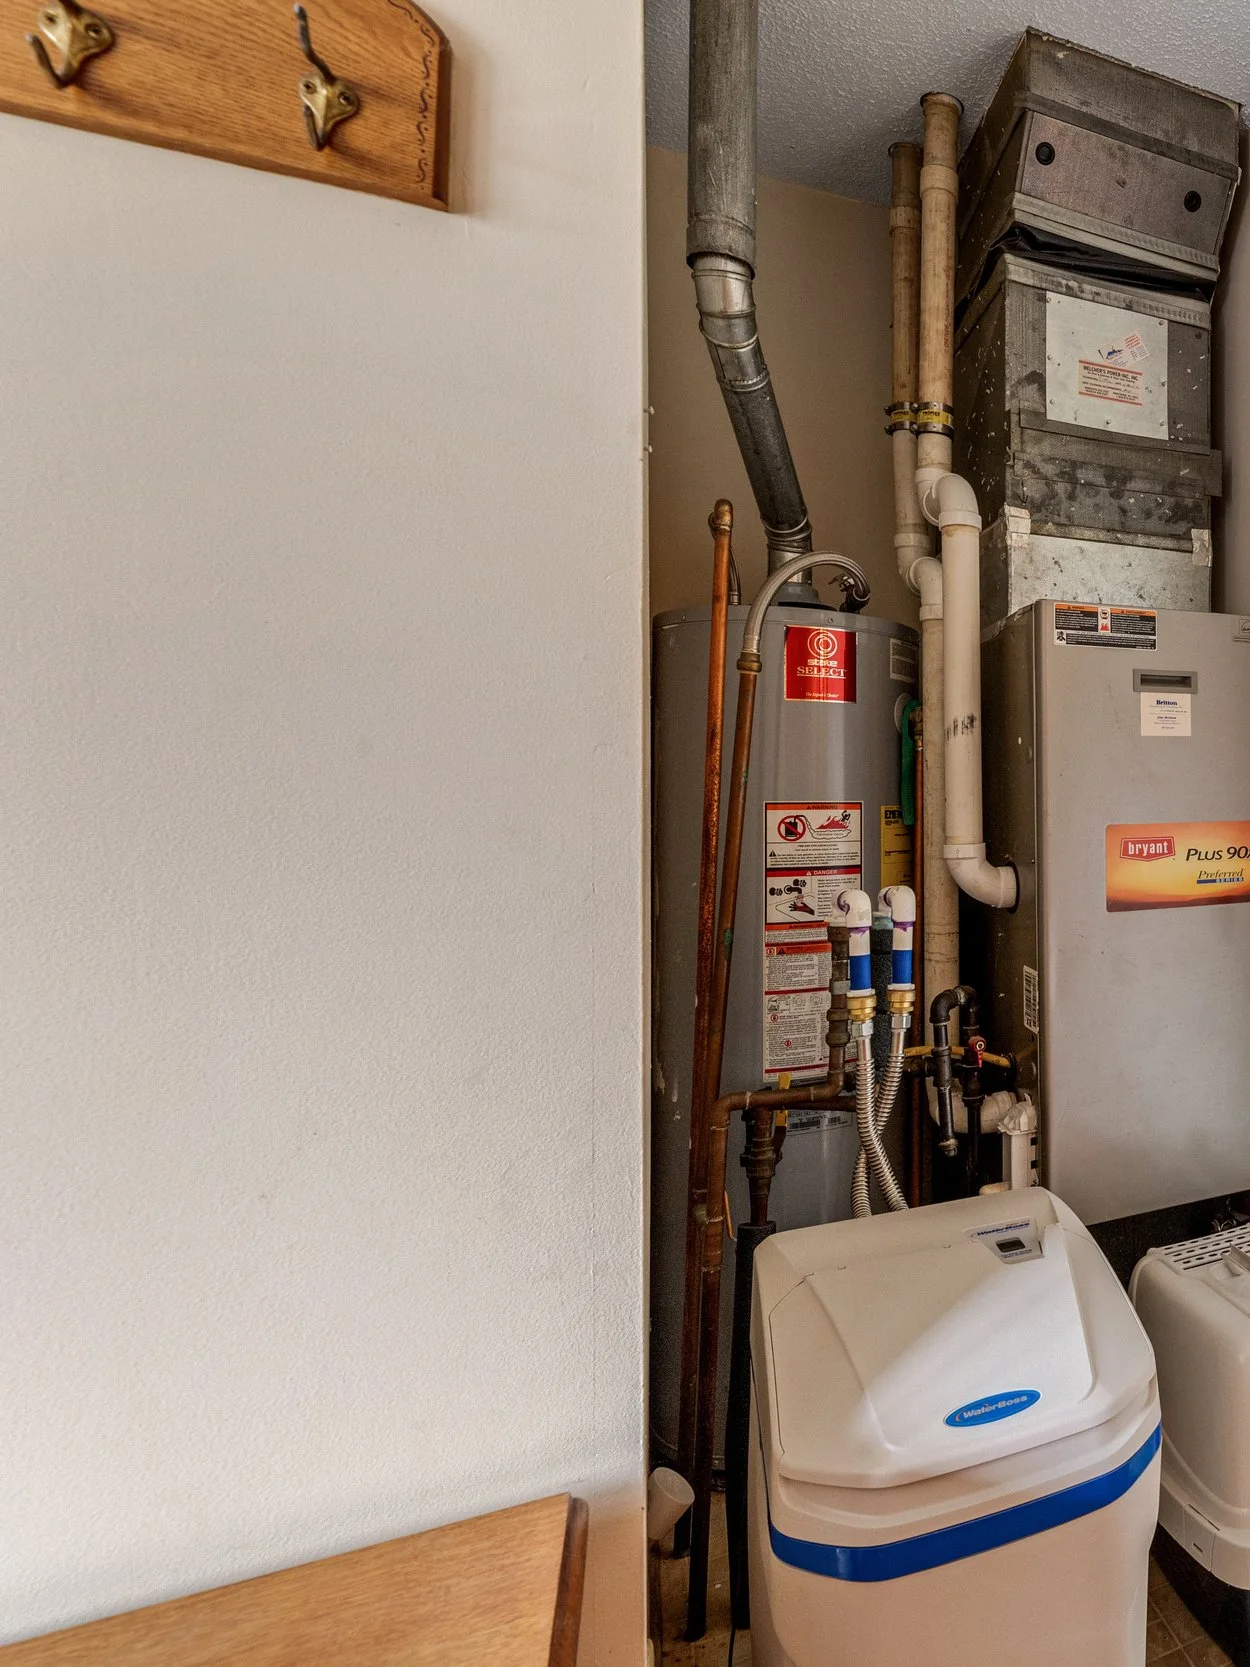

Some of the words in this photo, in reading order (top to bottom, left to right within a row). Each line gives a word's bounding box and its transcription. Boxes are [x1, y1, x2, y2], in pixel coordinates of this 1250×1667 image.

[796, 666, 846, 677] SELECT
[1128, 841, 1169, 856] bryant
[1198, 868, 1244, 880] Preferred
[963, 1395, 1028, 1418] WaterBoss
